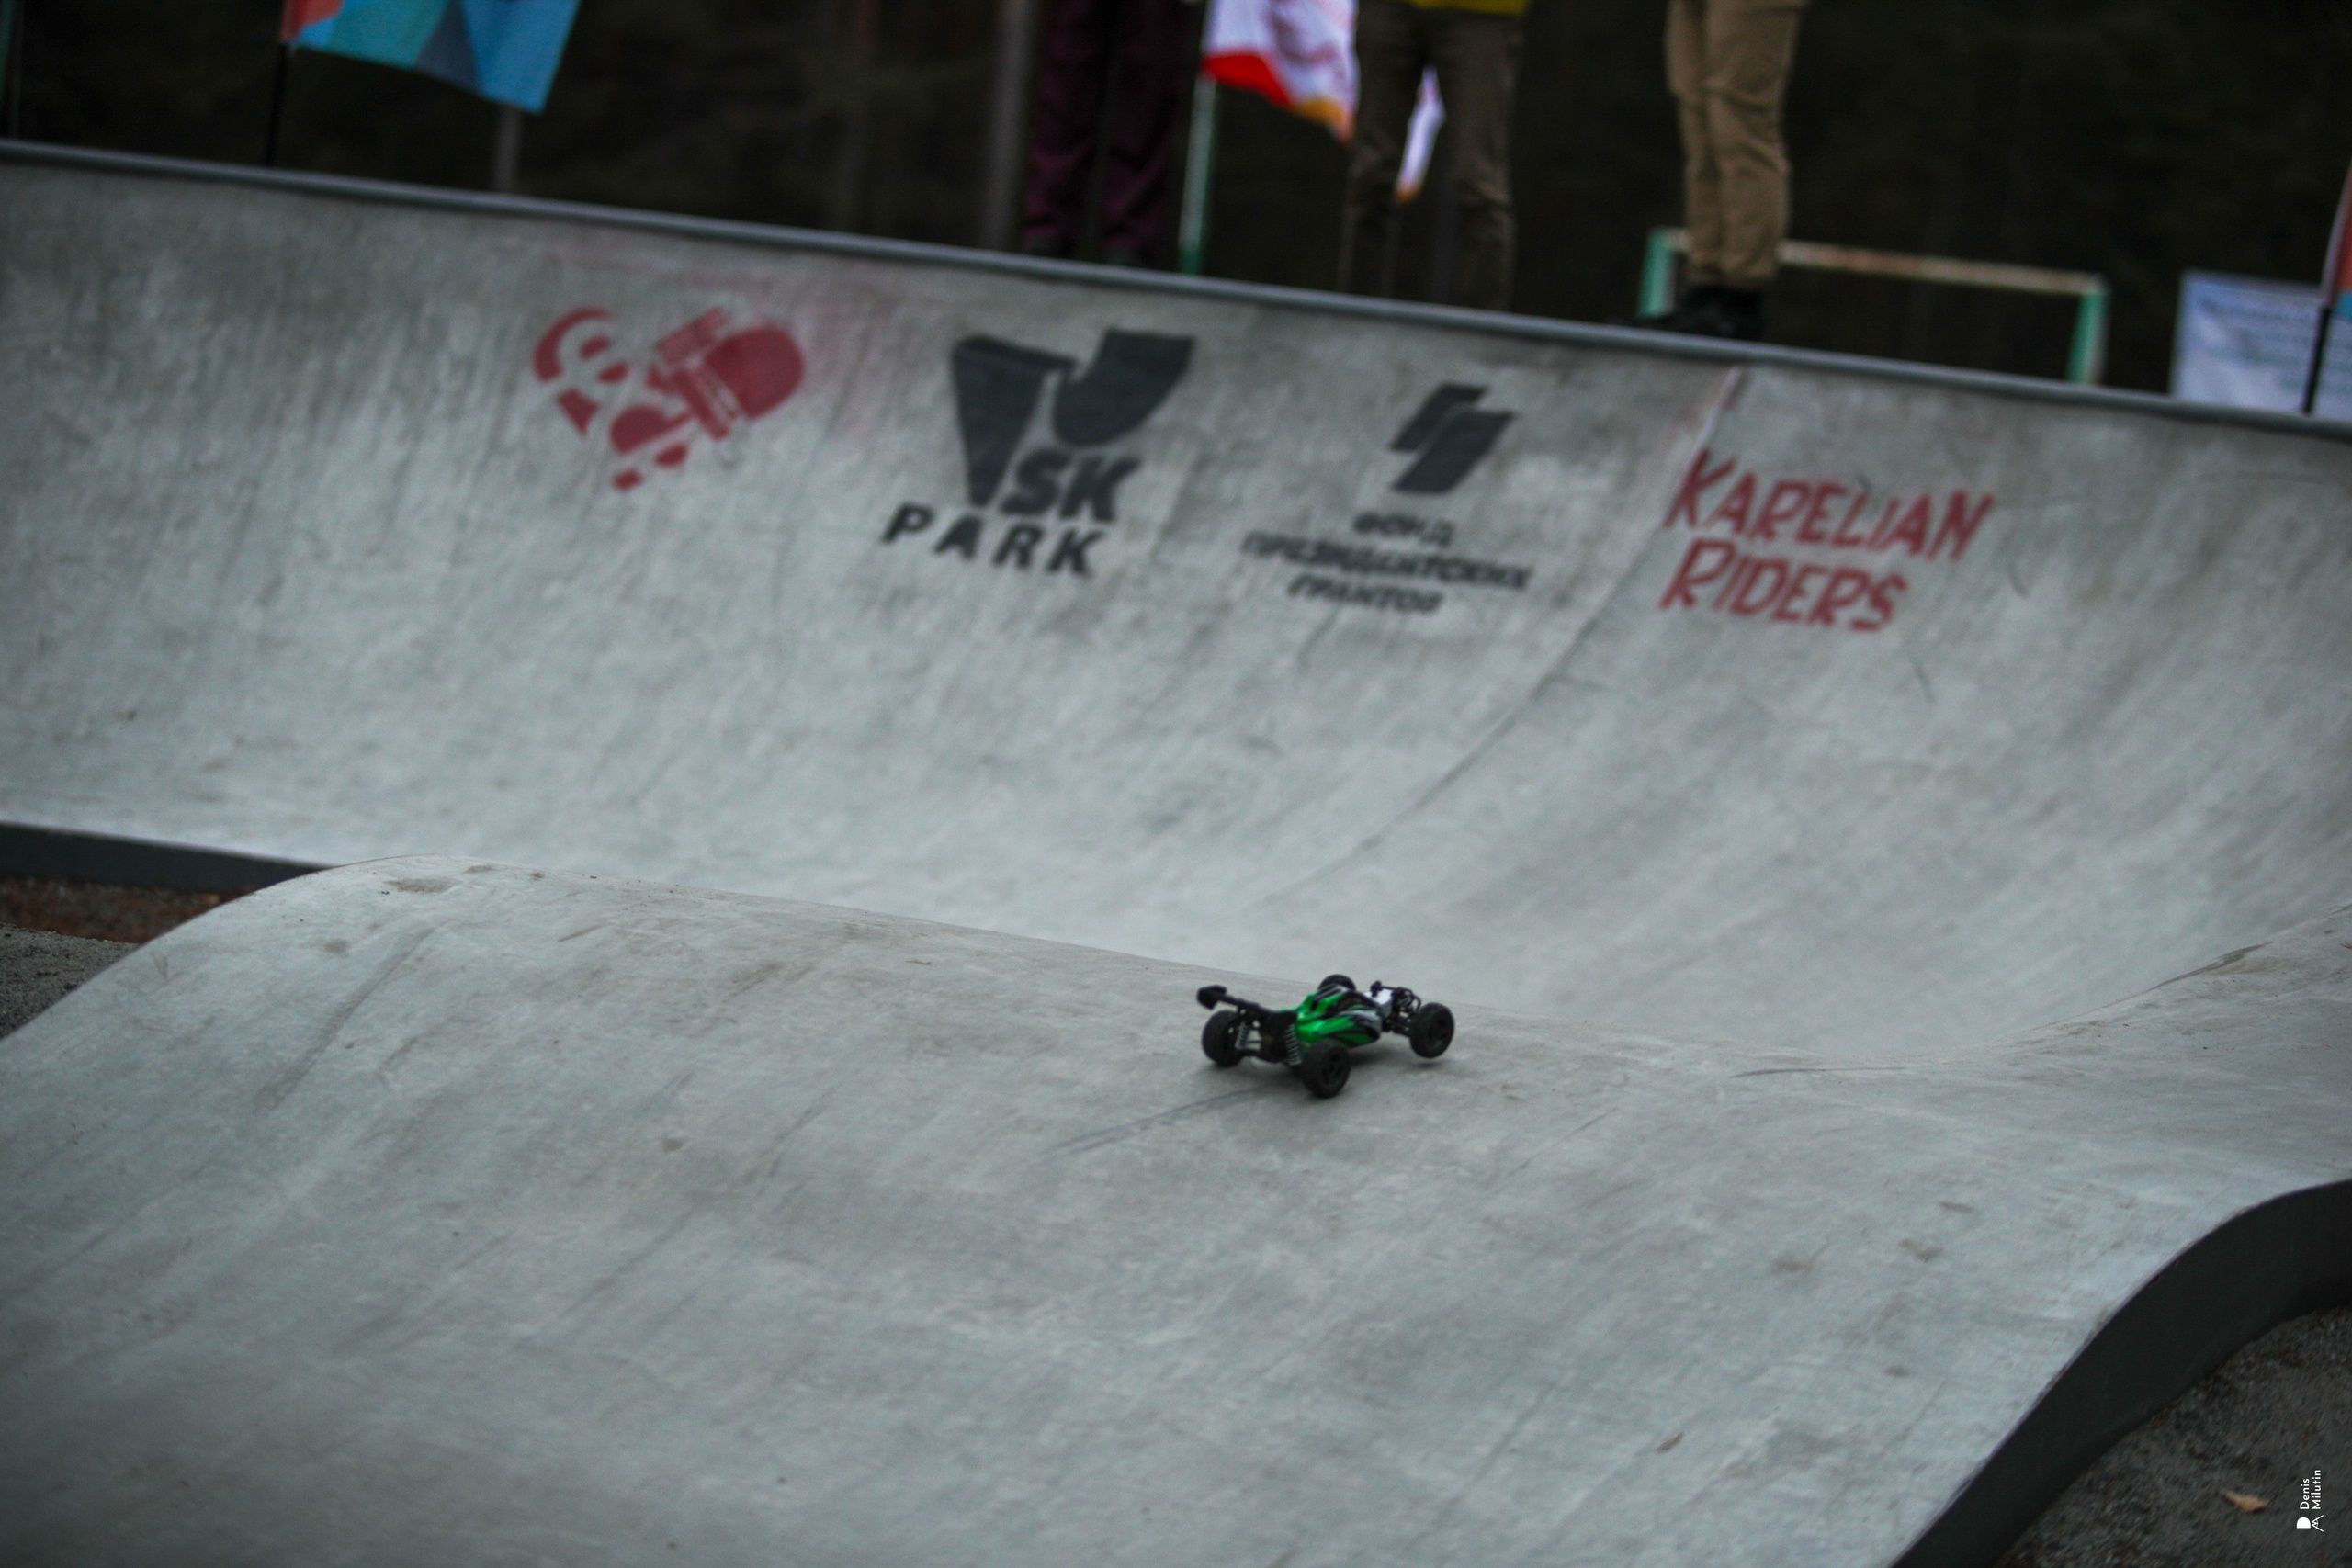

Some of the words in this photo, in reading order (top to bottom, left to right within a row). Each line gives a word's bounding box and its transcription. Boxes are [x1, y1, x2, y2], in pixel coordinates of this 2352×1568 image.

[881, 501, 1106, 580] PARK
[1662, 446, 1995, 563] KARELIAN
[1658, 537, 1908, 632] RIDERS
